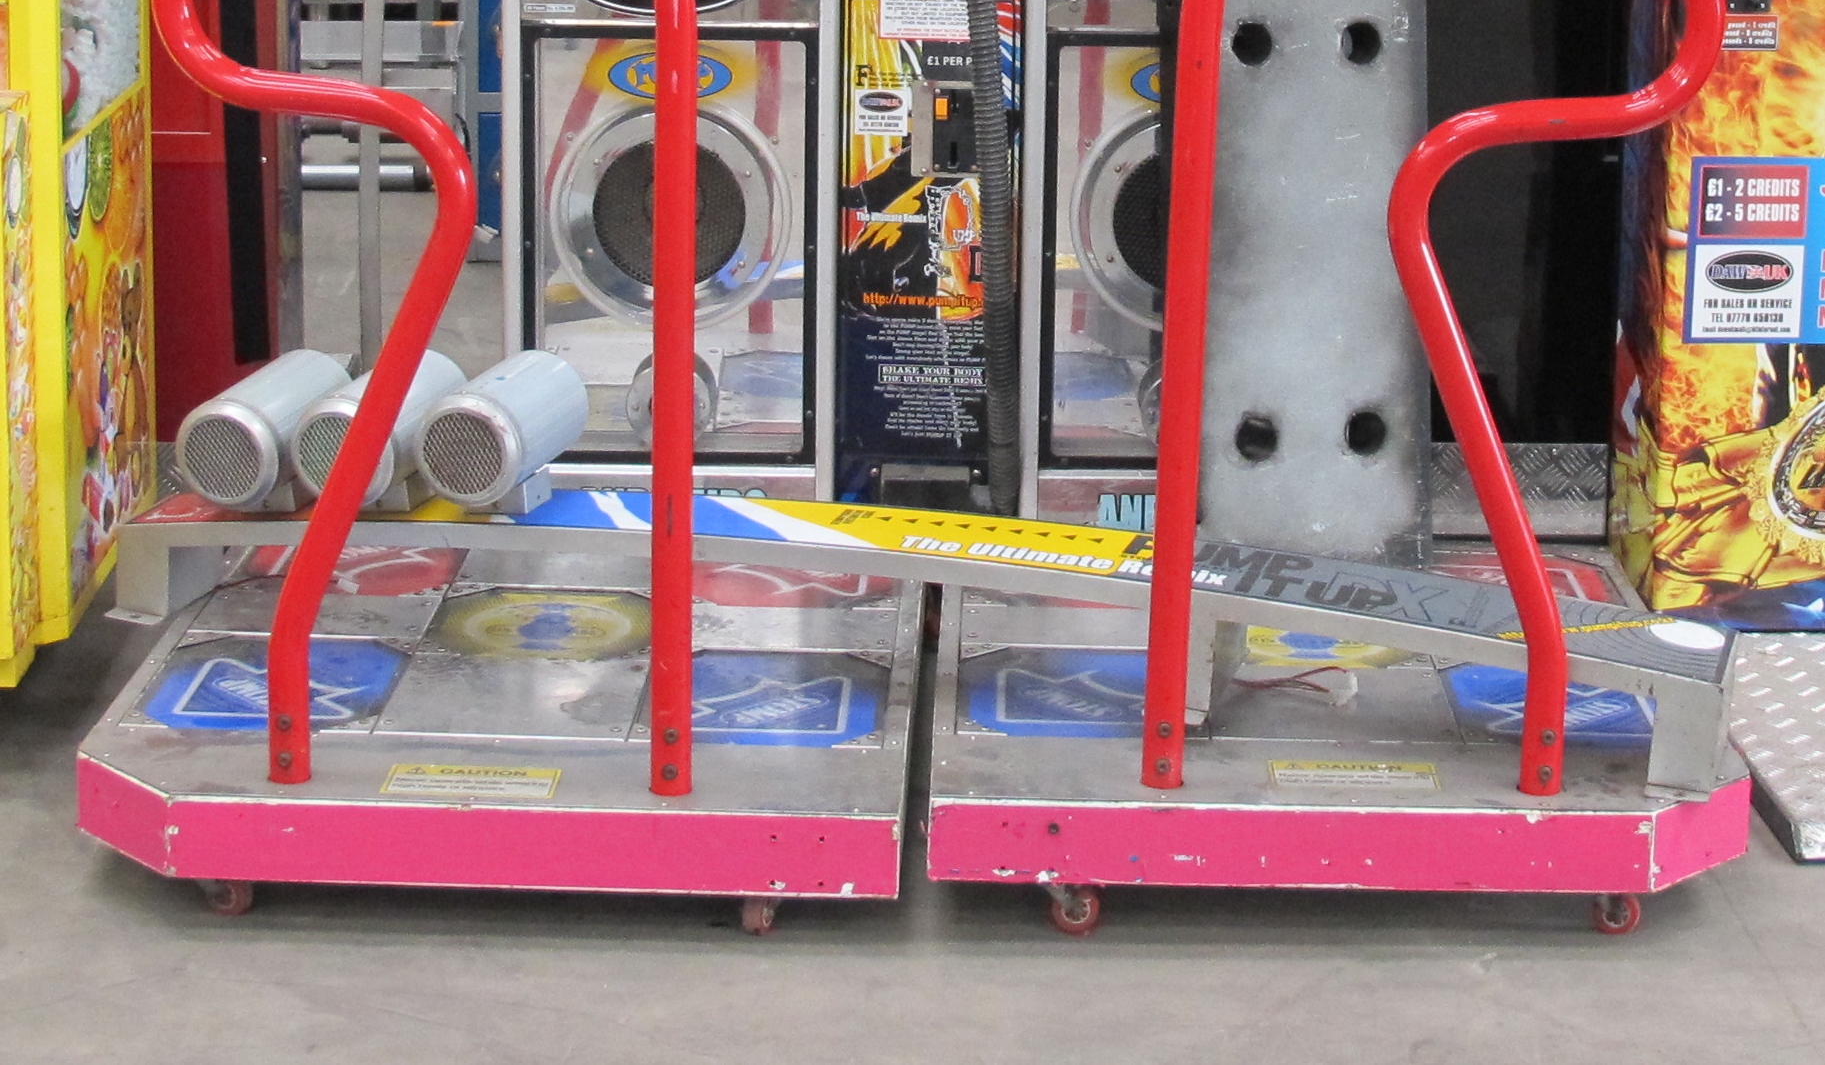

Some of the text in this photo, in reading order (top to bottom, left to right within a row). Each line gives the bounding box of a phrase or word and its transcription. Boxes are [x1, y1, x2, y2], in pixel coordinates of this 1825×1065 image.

[927, 56, 940, 66] £1
[943, 56, 963, 66] PER
[1707, 178, 1723, 197] £1
[1734, 178, 1744, 197] 2
[1747, 178, 1801, 197] CREDITS
[1705, 203, 1723, 222] £2
[1734, 203, 1744, 222] 5
[1747, 203, 1801, 222] CREDITS
[863, 292, 983, 308] http://www.pumpitup.
[1703, 298, 1793, 309] FOR SALES OR SERVICE
[1711, 313, 1724, 322] TEL
[953, 368, 983, 377] BODY
[901, 536, 1228, 587] The Ultimate Reix
[440, 768, 528, 777] CAUTION
